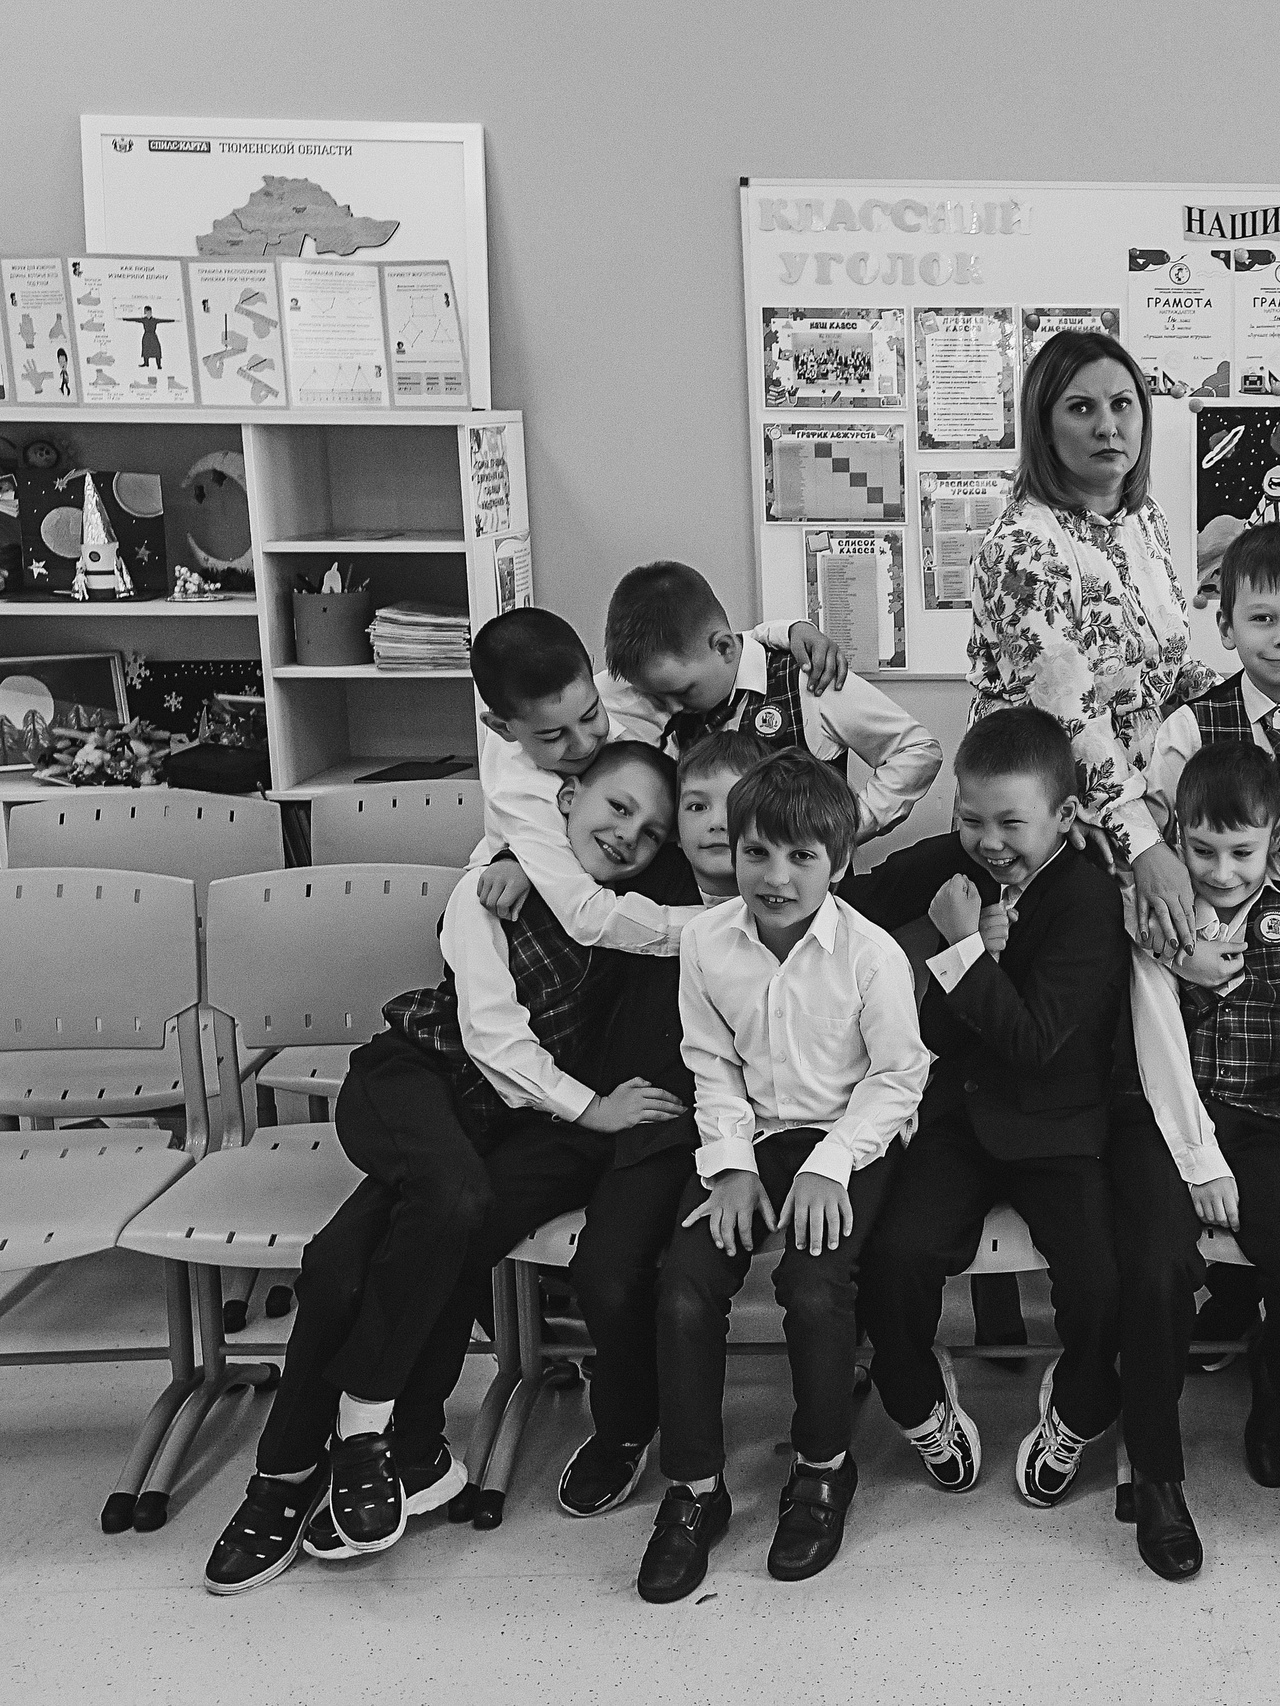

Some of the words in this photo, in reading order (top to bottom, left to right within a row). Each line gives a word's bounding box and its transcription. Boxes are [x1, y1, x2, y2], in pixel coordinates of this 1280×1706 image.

[219, 141, 295, 154] ТЮМЕНСКОЙ
[298, 144, 353, 156] ОБЛАСТИ
[758, 196, 1032, 235] КЛАССНЫЙ
[778, 251, 985, 286] УГОЛОК
[1147, 297, 1212, 308] ГРАМОТА
[809, 321, 828, 330] НАШ
[828, 321, 858, 330] КЛАСС
[796, 431, 828, 440] ГРАФИК
[830, 431, 876, 440] ДЕЖУРСТВ
[939, 480, 998, 488] РАСПИСАНИЕ
[951, 487, 987, 495] УРОКОВ
[838, 539, 876, 547] СПИСОК
[839, 547, 875, 555] КЛАССА
